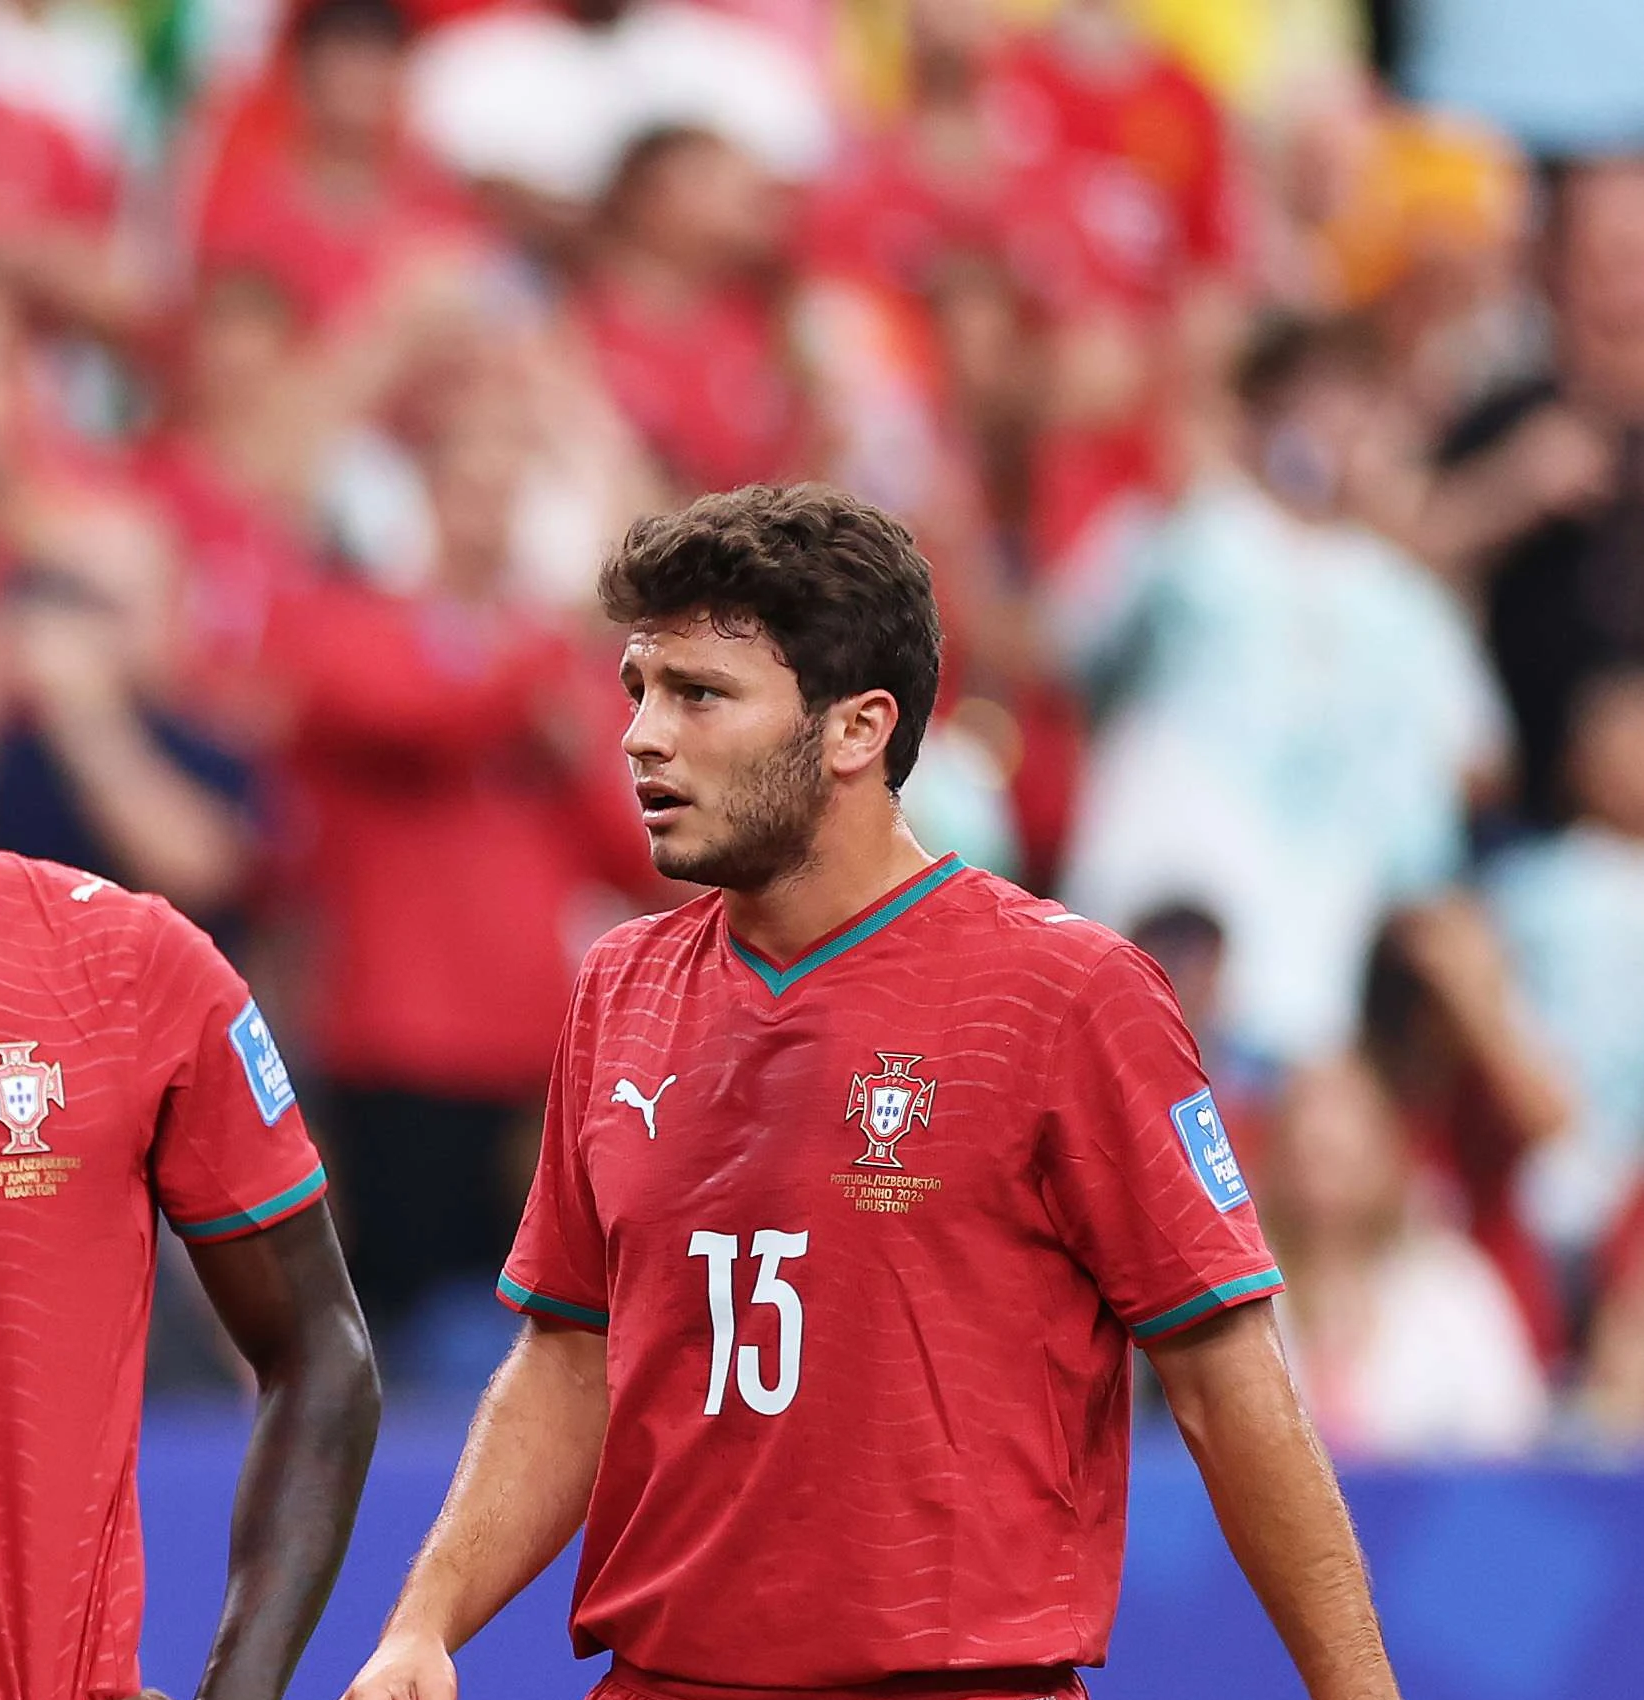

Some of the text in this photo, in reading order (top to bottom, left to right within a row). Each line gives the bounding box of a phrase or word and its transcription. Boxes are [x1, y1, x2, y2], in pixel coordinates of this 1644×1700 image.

[843, 1186, 856, 1199] 23
[859, 1186, 893, 1200] JUNHO
[855, 1199, 910, 1214] HOUSTON
[687, 1228, 809, 1417] 15
